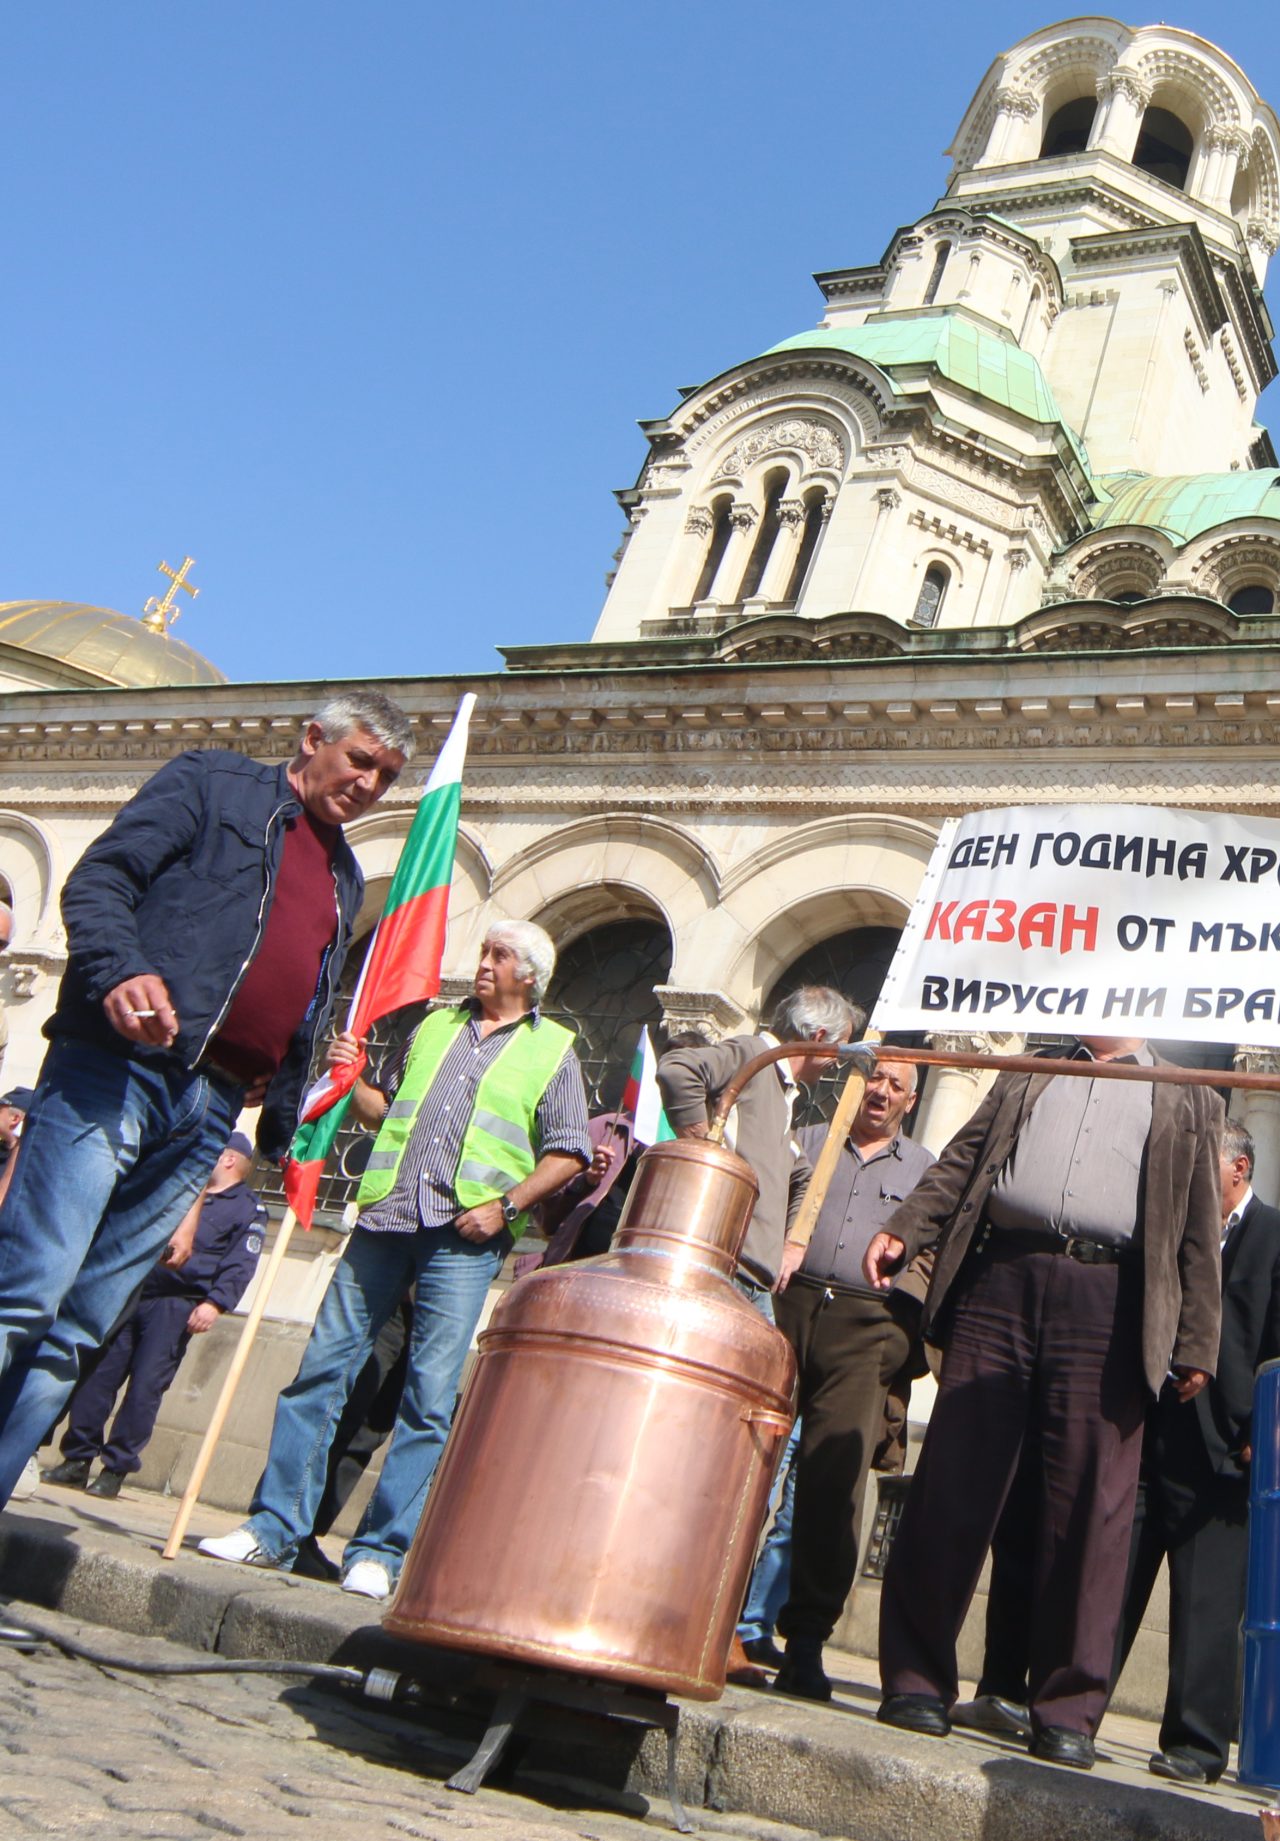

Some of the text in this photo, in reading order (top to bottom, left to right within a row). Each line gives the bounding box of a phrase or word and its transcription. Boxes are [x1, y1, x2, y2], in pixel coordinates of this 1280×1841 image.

[947, 833, 1019, 869] ДЕН
[1030, 831, 1207, 880] ГОДИНА
[924, 899, 1098, 954] КАЗАН
[1117, 914, 1175, 952] ОТ
[920, 975, 1088, 1014] ВИРУСИ
[1101, 987, 1166, 1019] НИ
